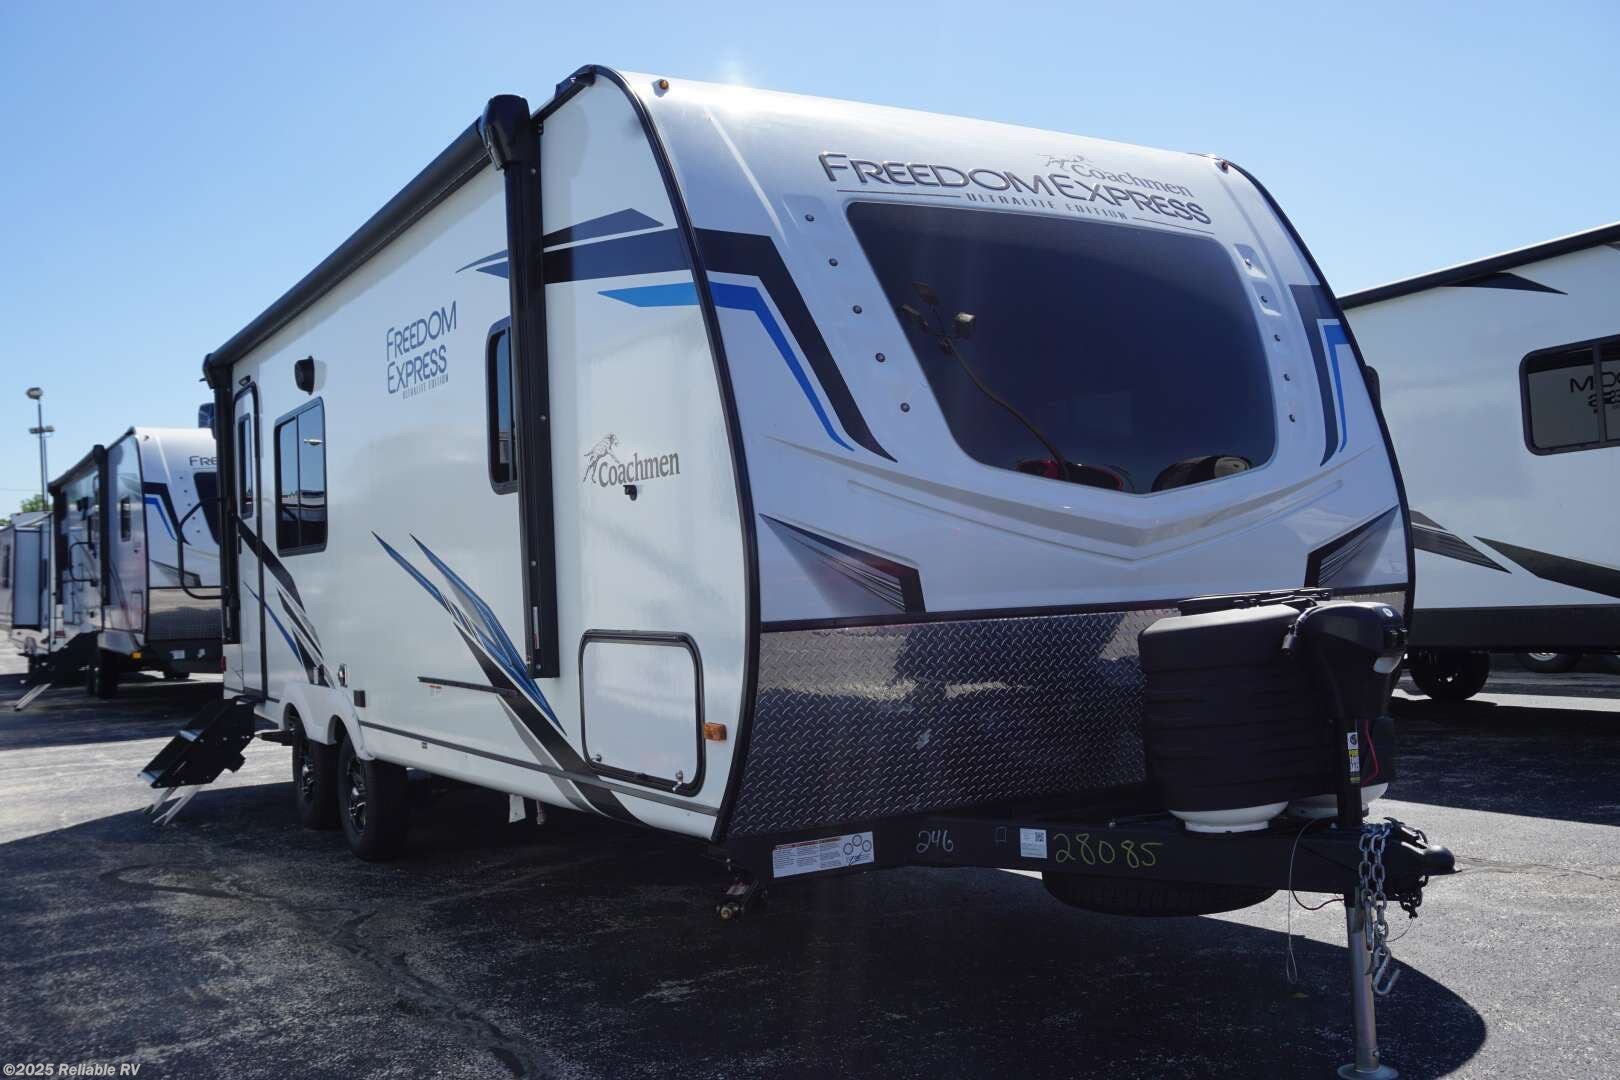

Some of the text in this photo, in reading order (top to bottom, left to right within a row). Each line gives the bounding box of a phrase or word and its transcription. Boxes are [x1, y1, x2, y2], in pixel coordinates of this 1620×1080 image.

[818, 151, 1212, 225] FREEDOM EXPRESS
[1071, 163, 1195, 198] Coachmen
[386, 300, 457, 361] FREEDOM
[387, 344, 448, 394] EXPRESS
[598, 452, 681, 488] Coachmen
[917, 829, 954, 853] 246
[1053, 833, 1164, 869] 28085
